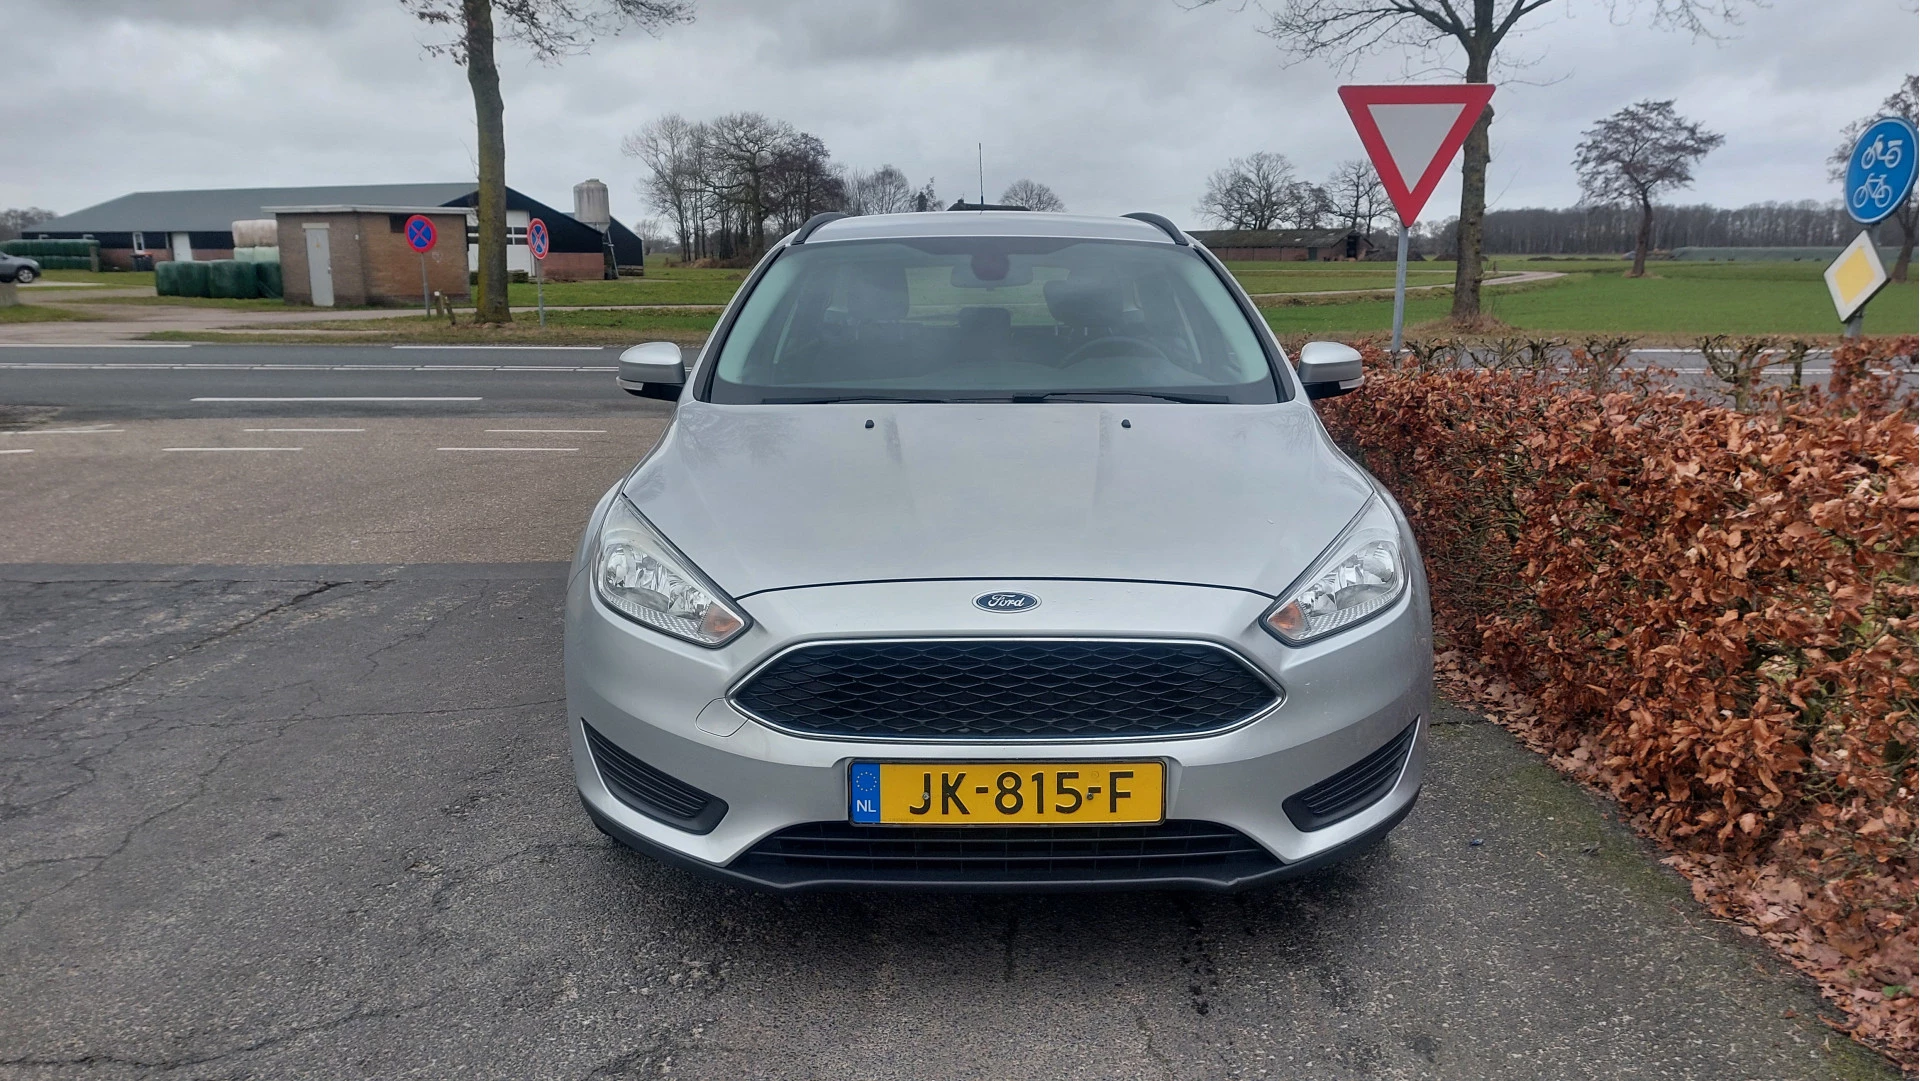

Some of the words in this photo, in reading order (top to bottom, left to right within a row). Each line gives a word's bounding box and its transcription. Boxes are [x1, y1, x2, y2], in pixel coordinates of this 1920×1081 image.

[987, 594, 1025, 607] Ford
[909, 771, 1134, 815] JK-815-F
[856, 800, 876, 813] NL
